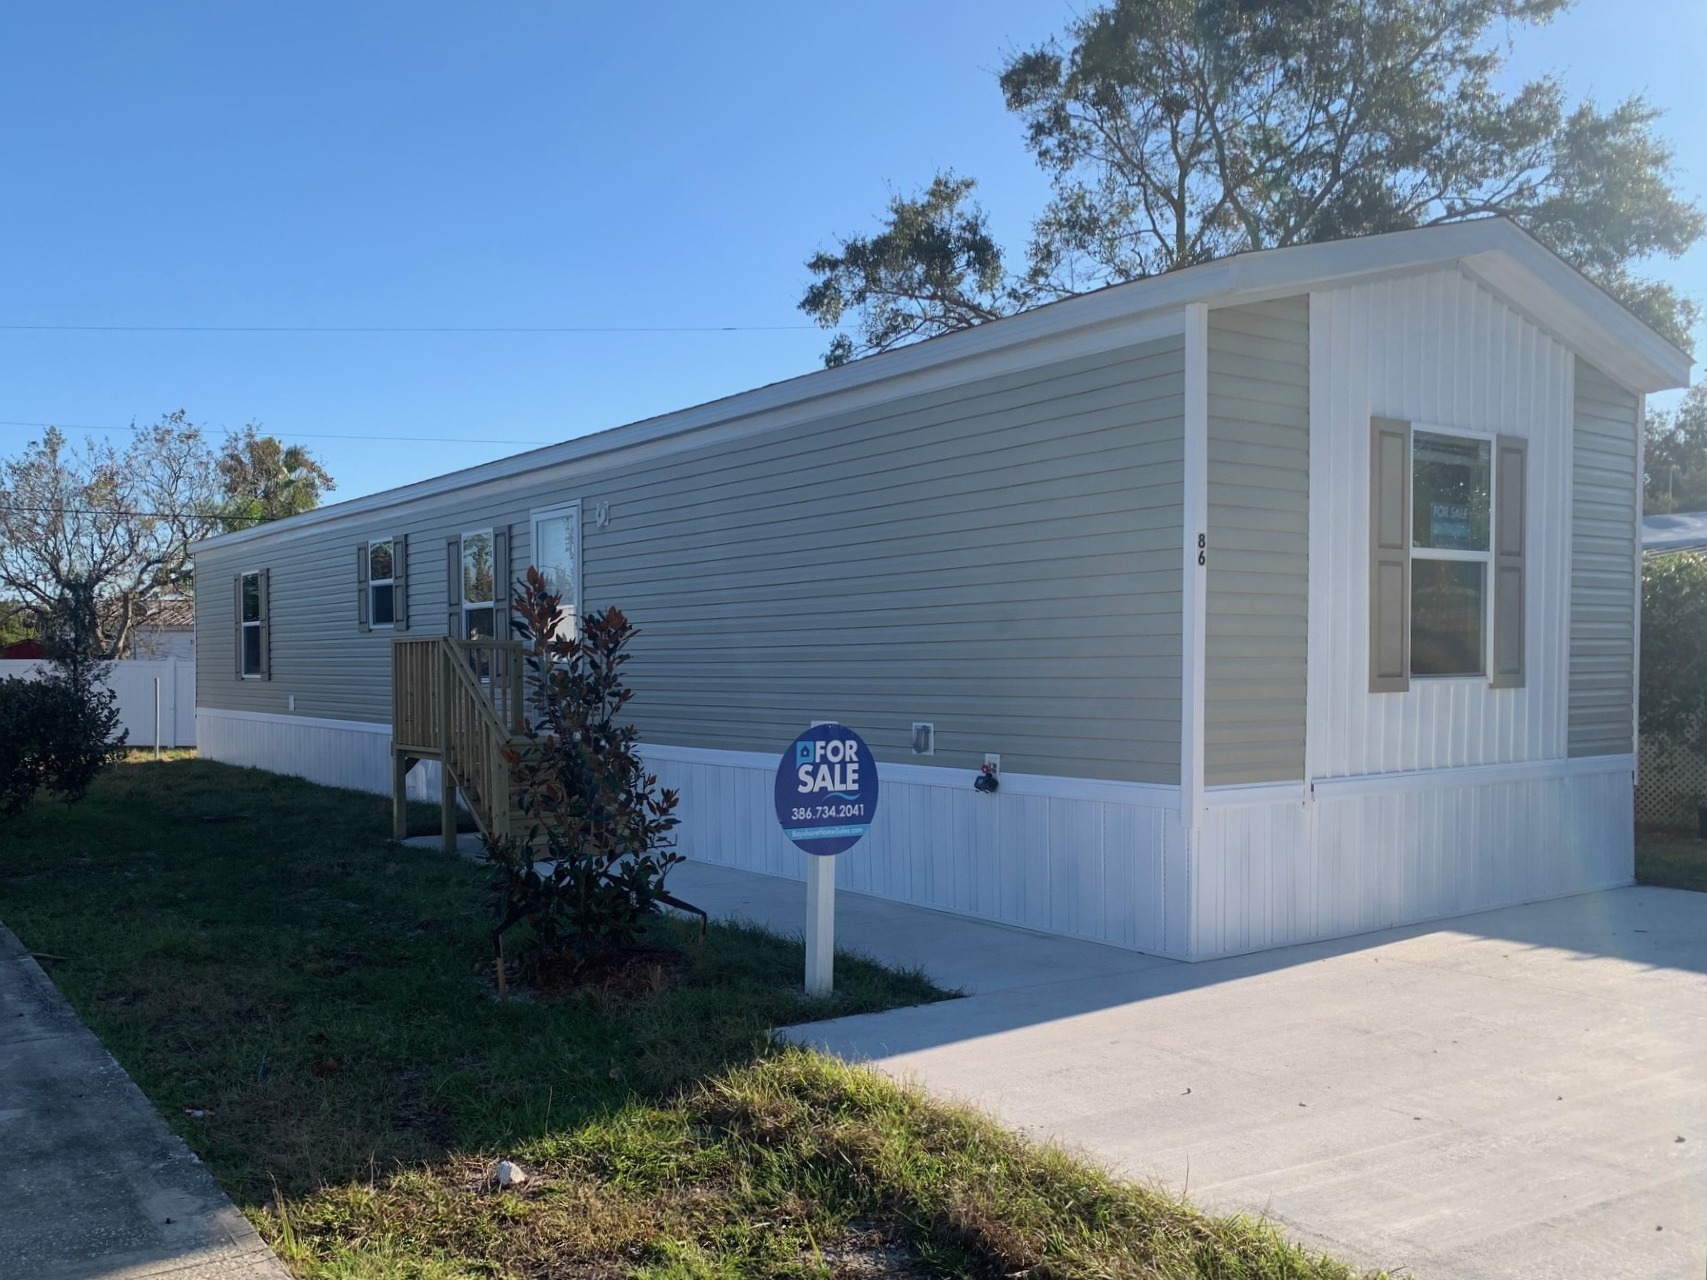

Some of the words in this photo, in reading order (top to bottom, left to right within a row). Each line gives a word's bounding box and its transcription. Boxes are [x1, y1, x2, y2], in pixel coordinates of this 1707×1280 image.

[1198, 533, 1206, 566] 86
[815, 740, 859, 763] FOR
[797, 763, 859, 793] SALE
[791, 804, 864, 820] 386.734.2041
